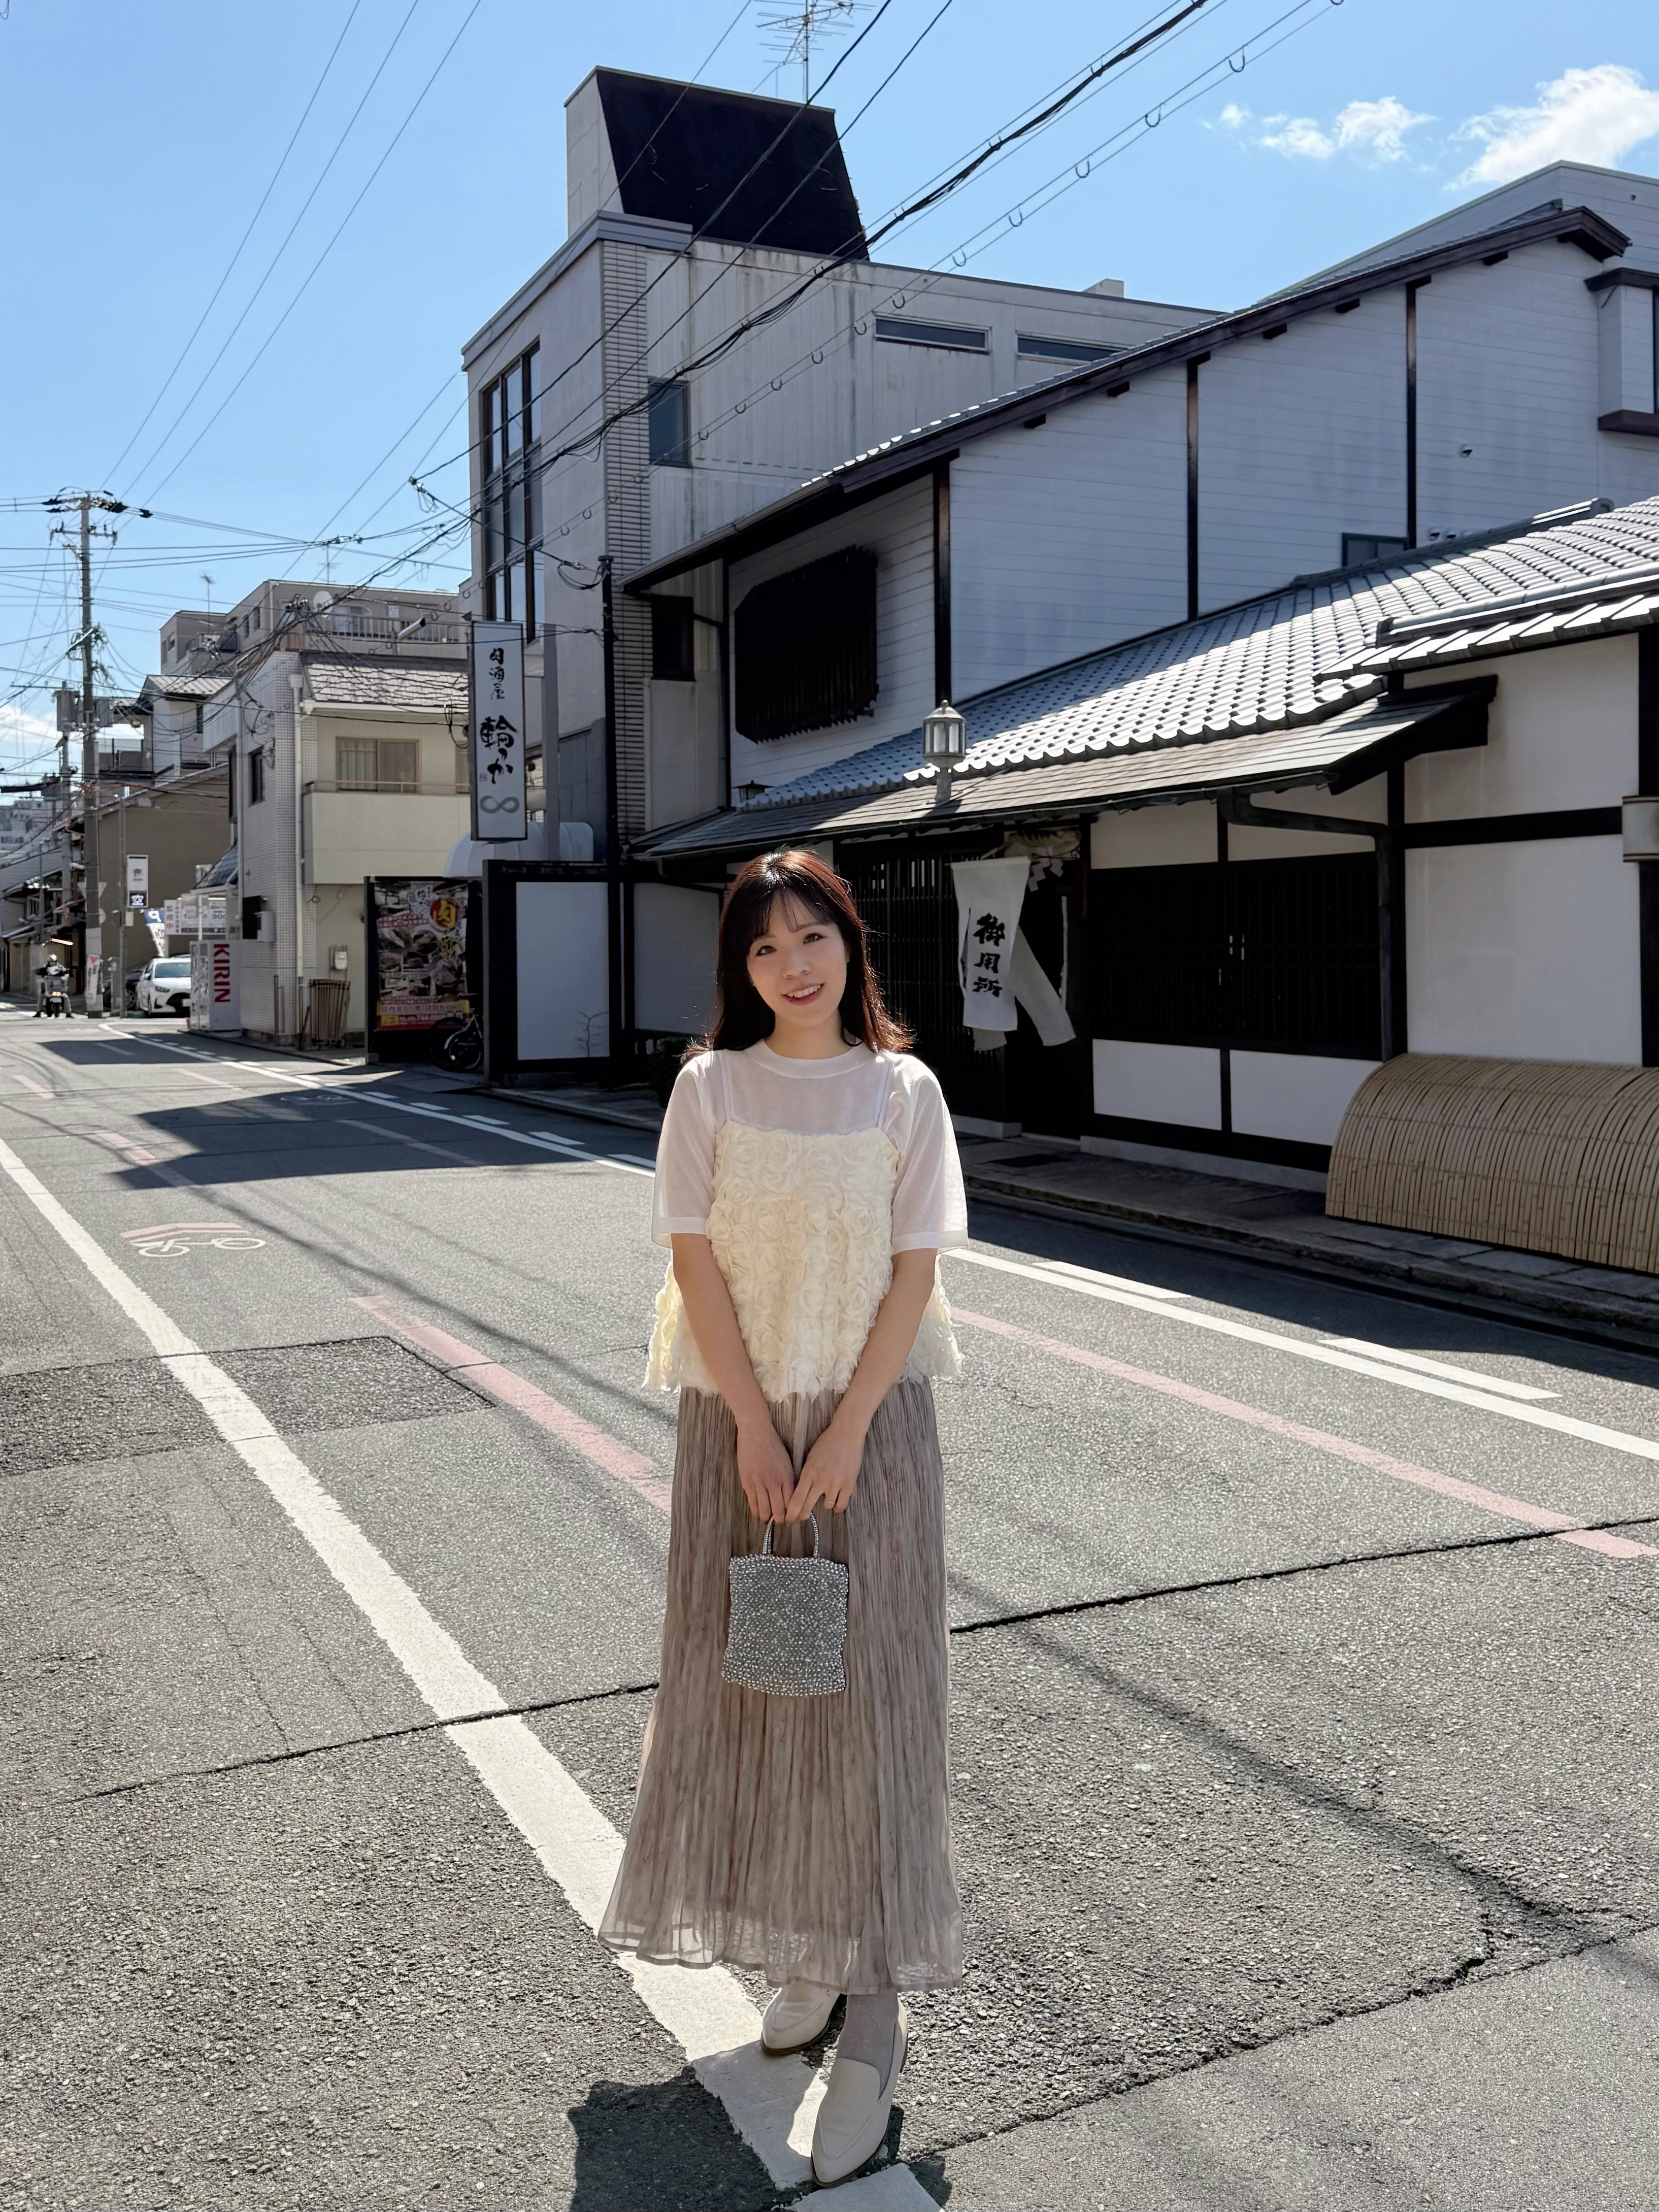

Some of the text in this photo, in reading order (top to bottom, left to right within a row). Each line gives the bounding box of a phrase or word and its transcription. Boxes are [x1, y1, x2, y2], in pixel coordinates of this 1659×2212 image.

[131, 894, 144, 906] 空
[214, 944, 230, 1002] KIRIN
[972, 913, 1005, 997] 御用所
